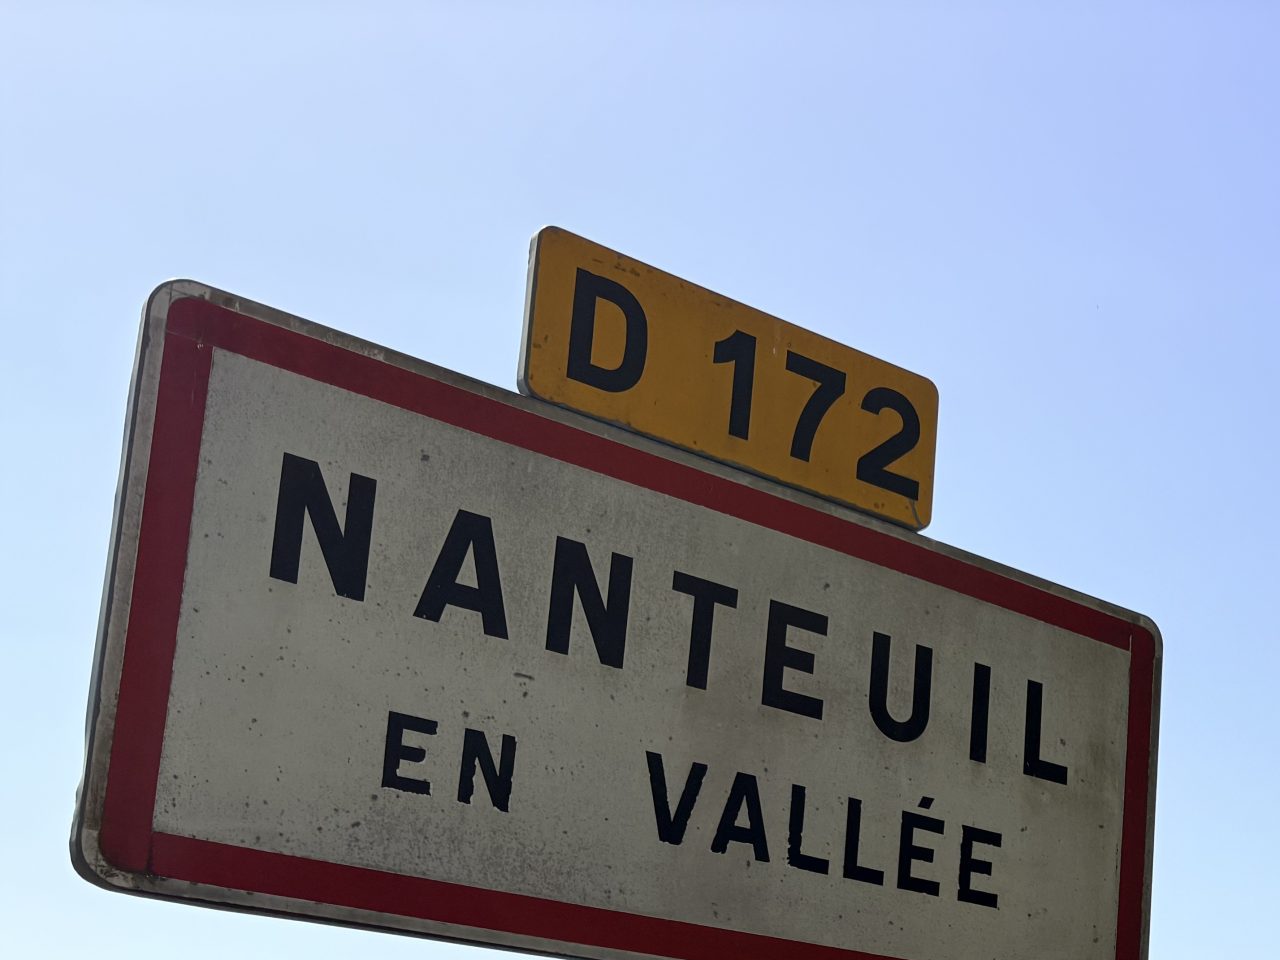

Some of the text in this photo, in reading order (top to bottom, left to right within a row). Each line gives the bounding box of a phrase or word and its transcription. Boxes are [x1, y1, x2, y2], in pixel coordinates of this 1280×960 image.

[565, 267, 920, 501] D 172
[268, 452, 1069, 785] NANTEUIL
[381, 710, 1003, 908] EN VALLÉE
